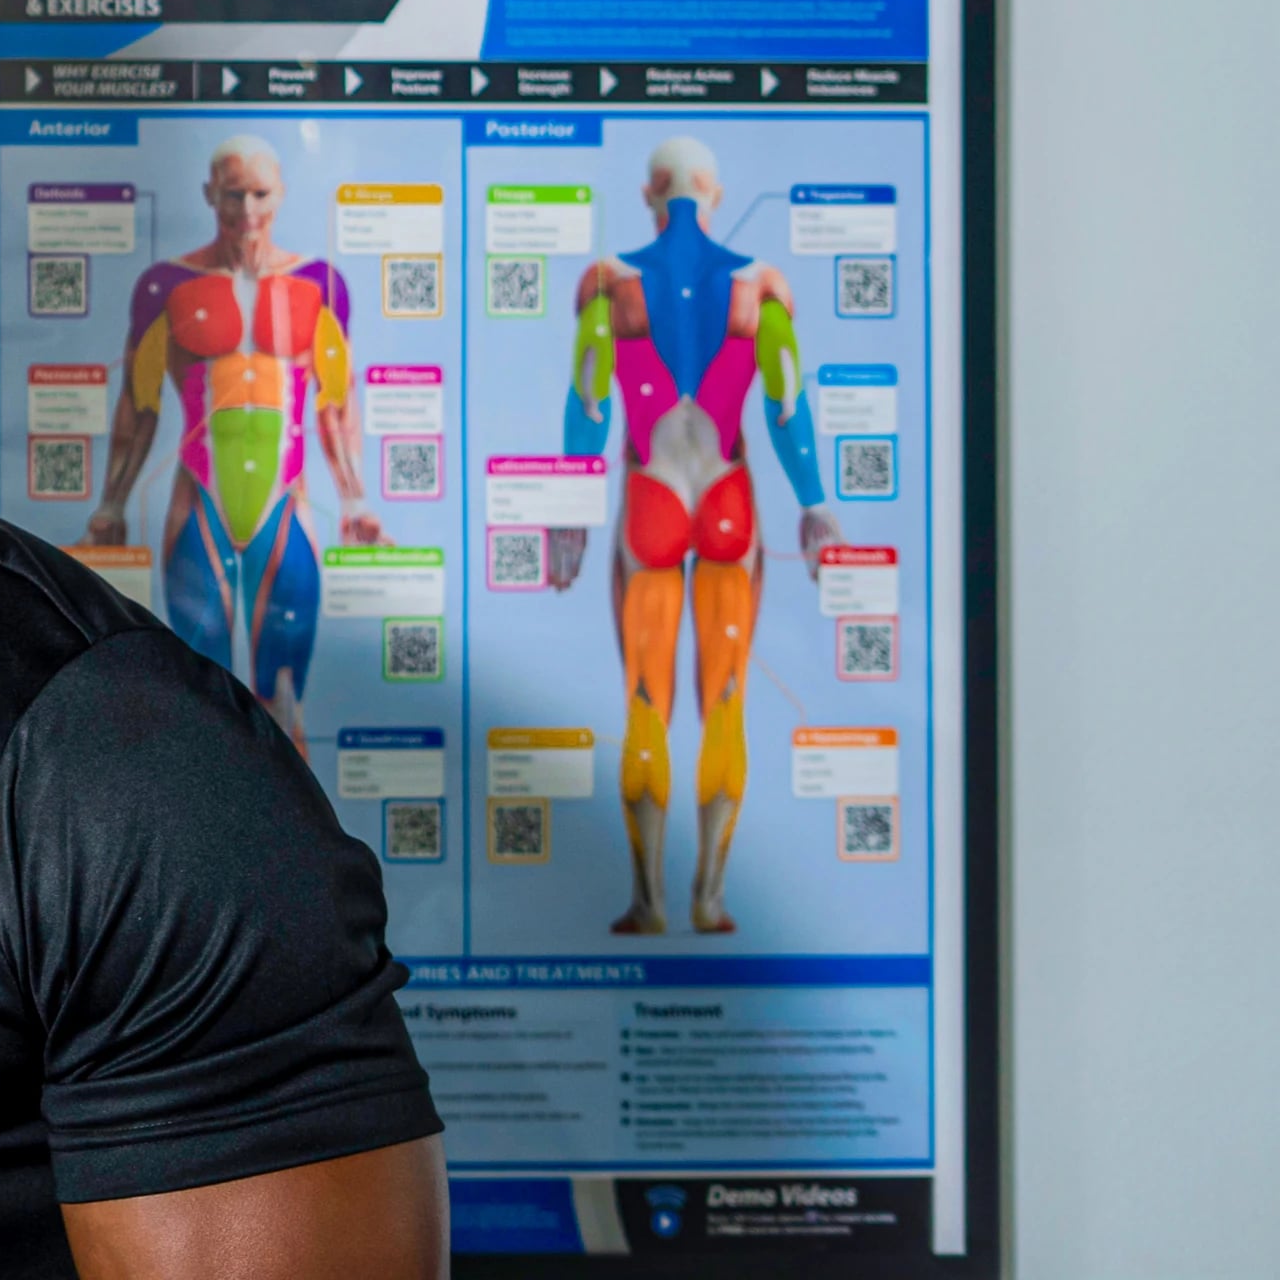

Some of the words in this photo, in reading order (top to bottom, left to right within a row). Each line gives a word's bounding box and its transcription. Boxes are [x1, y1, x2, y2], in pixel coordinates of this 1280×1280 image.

[53, 65, 87, 78] WHY
[90, 65, 163, 78] EXERCISE
[29, 120, 111, 136] Anterior
[486, 121, 574, 138] Posterior
[707, 1185, 776, 1207] Demo
[781, 1185, 858, 1208] Videos
